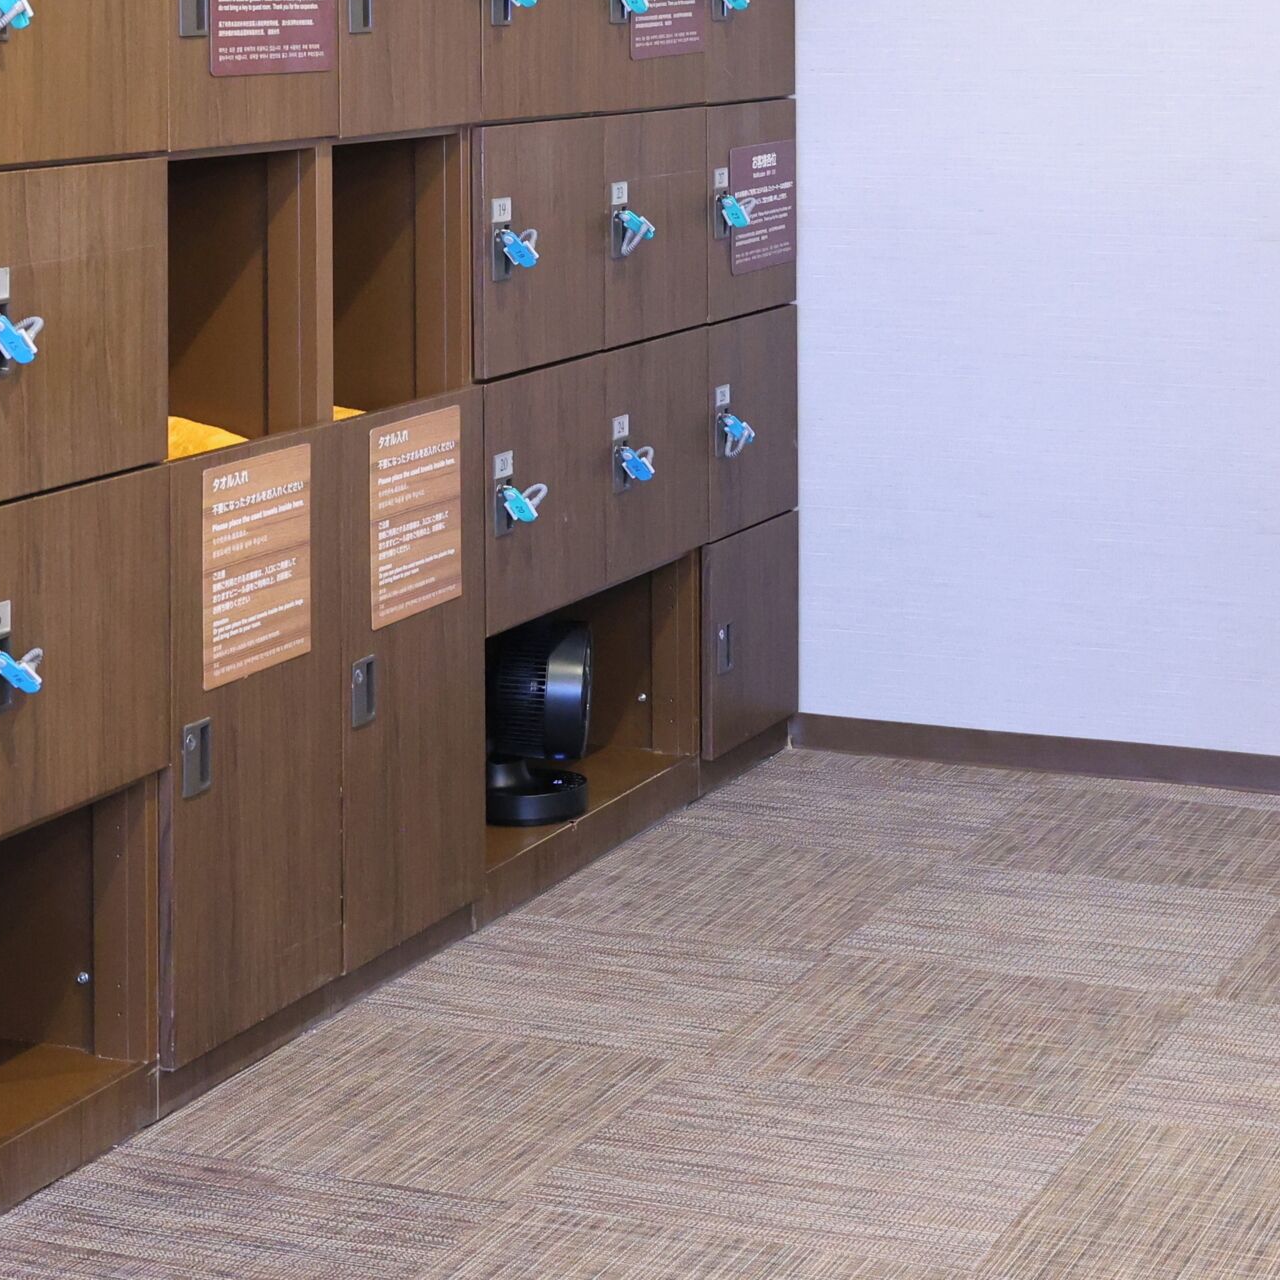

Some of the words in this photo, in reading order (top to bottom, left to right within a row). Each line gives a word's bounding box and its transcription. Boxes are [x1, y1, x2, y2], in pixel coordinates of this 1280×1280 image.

[377, 430, 408, 449] タオル入れ
[212, 470, 249, 492] タオル入れ
